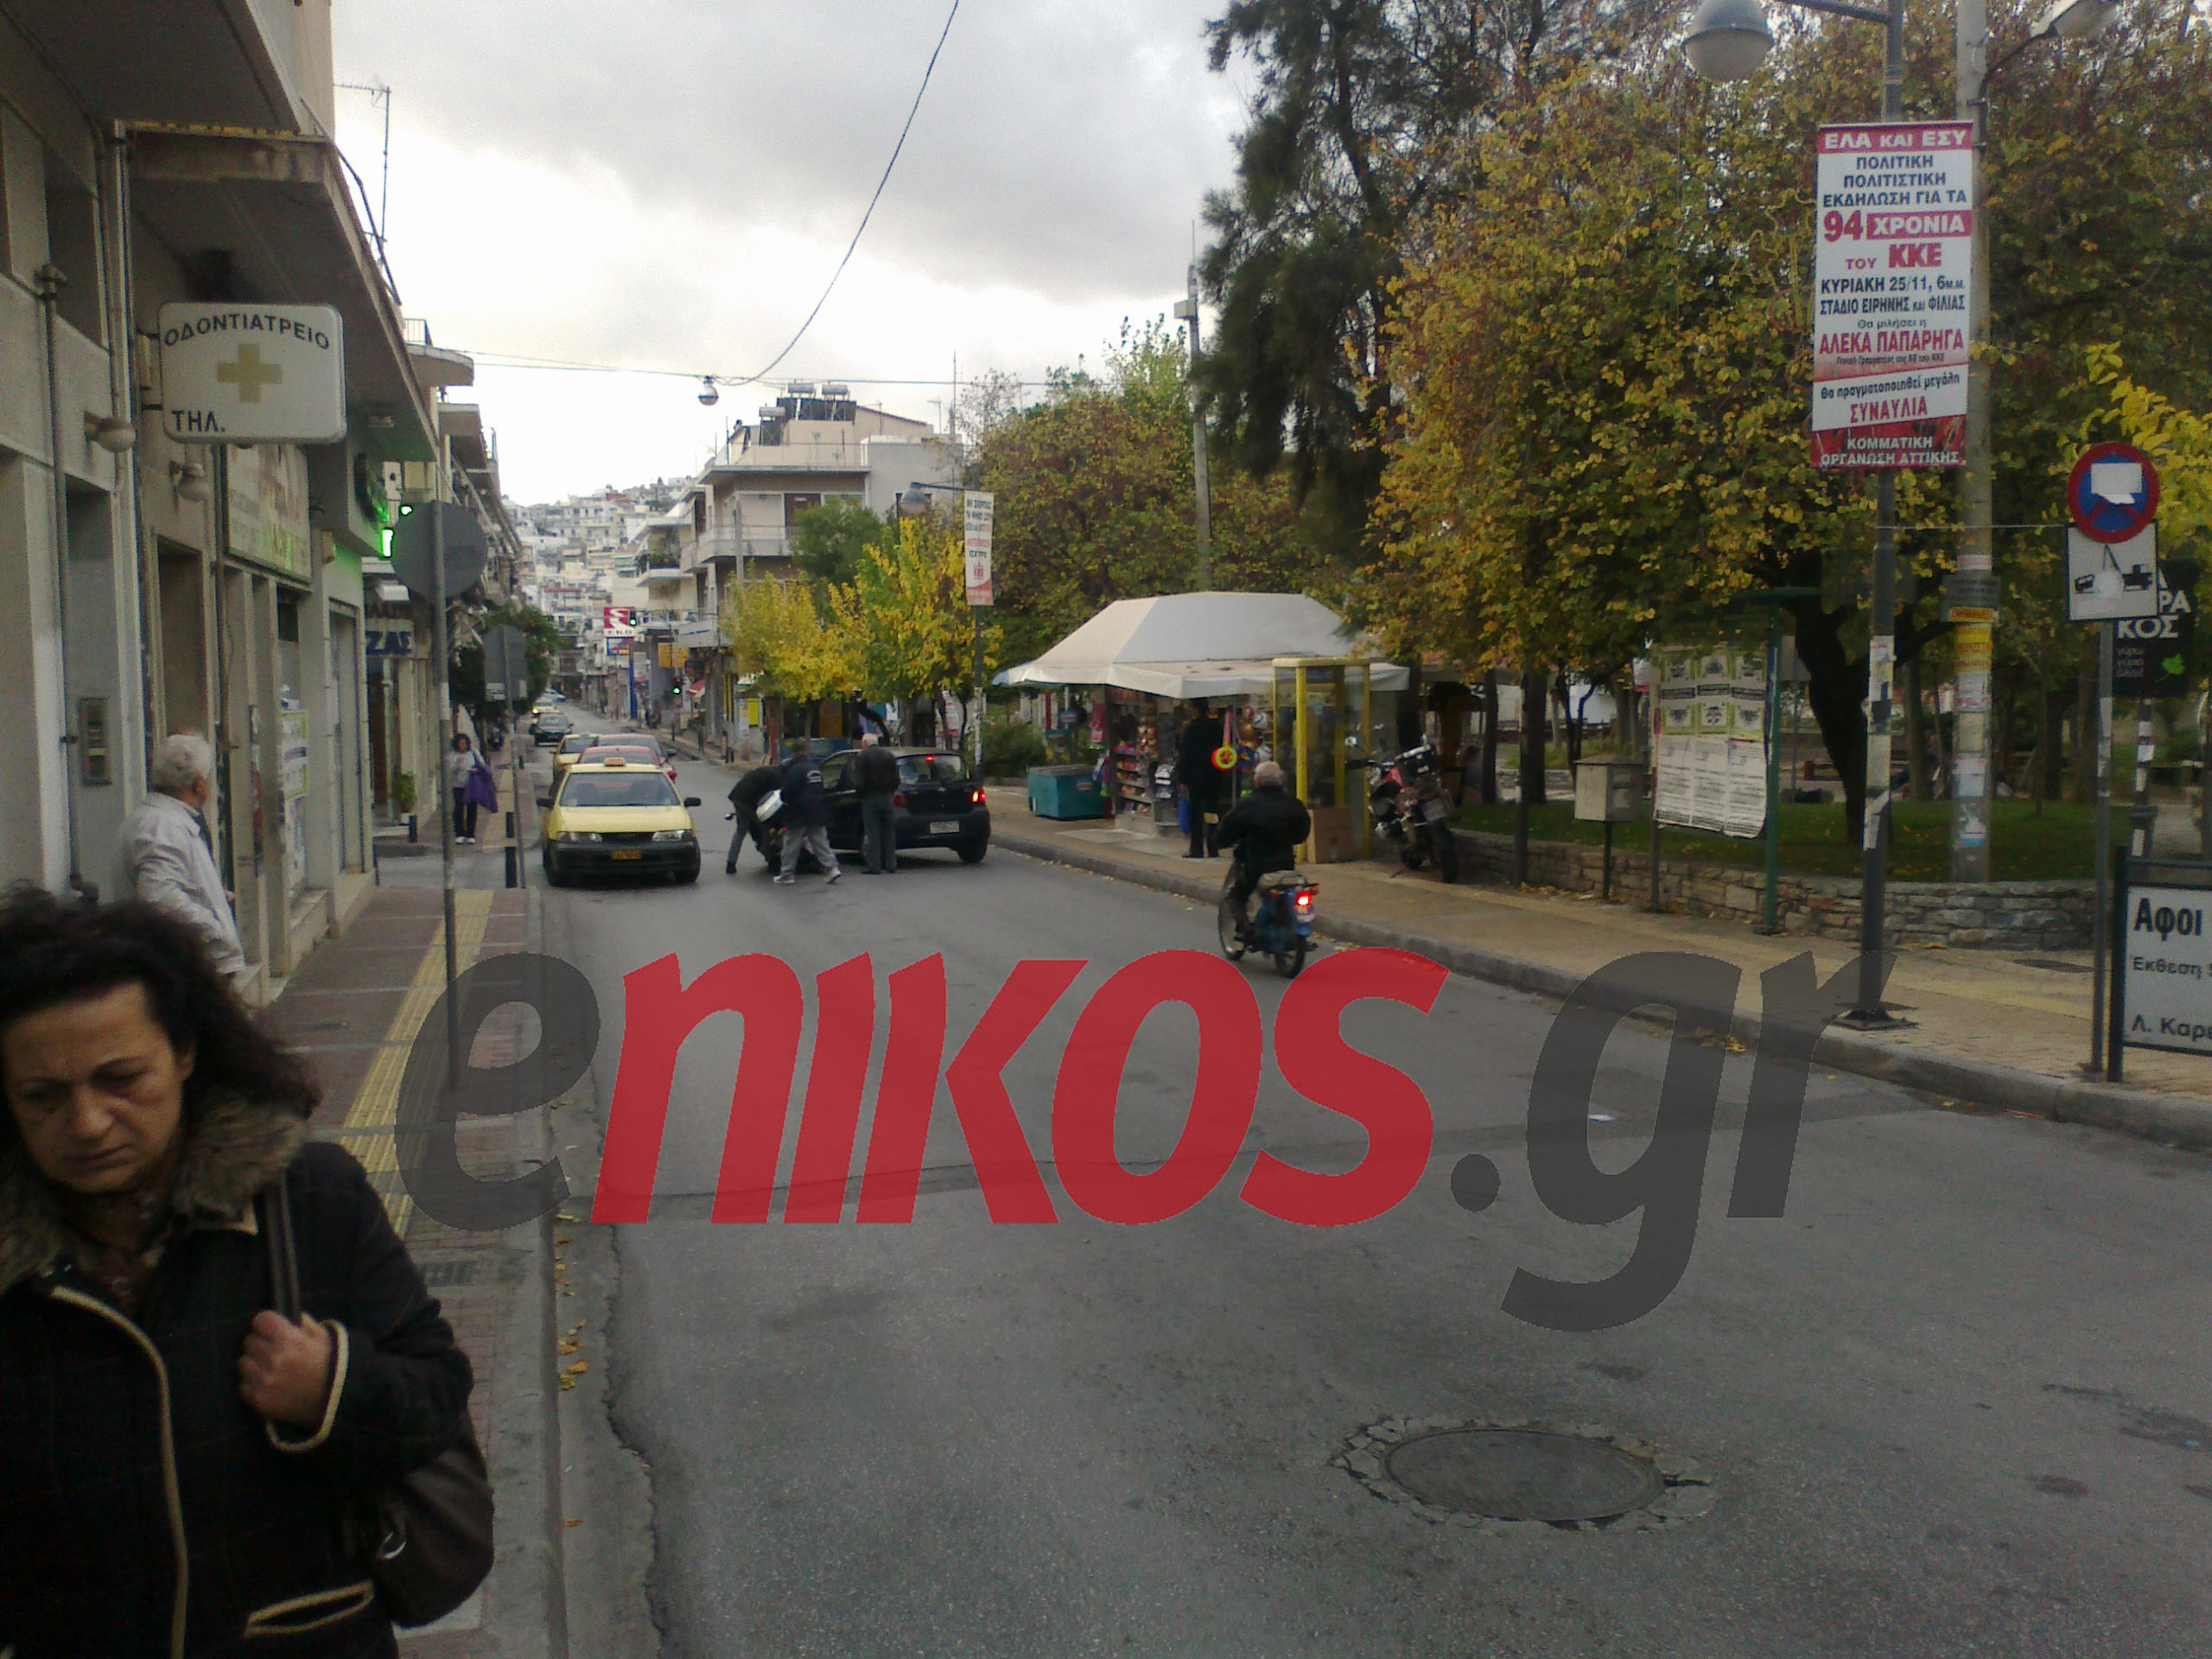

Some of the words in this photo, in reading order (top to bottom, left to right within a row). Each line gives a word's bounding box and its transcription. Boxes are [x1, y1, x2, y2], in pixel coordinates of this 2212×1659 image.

[1824, 132, 1872, 149] ΕΛΑ
[1879, 134, 1913, 148] ΚΑΙ
[1922, 130, 1967, 147] ΕΣΥ
[1856, 155, 1934, 170] ΠΟΛΙΤΙΚΗ
[1843, 172, 1946, 188] ΠΟΛΙΤΙΣΤΙΚΗ
[1823, 191, 1910, 207] ΕΚΔΗΛΩΣΗ
[1916, 190, 1941, 204] ΓΙΑ
[1946, 189, 1967, 203] ΤΑ
[1823, 210, 1864, 243] 94
[1873, 214, 1965, 236] ΧΡΟΝΙΑ
[1845, 257, 1877, 270] ΤΟΥ
[1888, 242, 1942, 269] ΚΚΕ
[1821, 276, 1885, 294] ΚΥΡΙΑΚΗ
[1889, 276, 1933, 293] 25/11,
[1820, 298, 1859, 315] ΣΤΑΔΙΟ
[1862, 296, 1910, 314] ΕΙΡΗΝΗΣ
[1928, 294, 1965, 311] ΦΙΛΙΑΣ
[164, 313, 330, 350] ΟΔΟΝΤΙΑΤΡΕΙΟ
[1858, 319, 1873, 329] Θα
[1877, 317, 1916, 330] μιλήσει
[1819, 332, 1872, 354] ΑΛΕΚΑ
[1877, 328, 1964, 353] ΠΑΠΑΡΗΓΑ
[1837, 374, 1922, 400] πραγματοποιηθεί
[1924, 372, 1960, 391] μεγάλη
[1850, 395, 1929, 423] ΣΥΝΑΥΛΙΑ
[171, 410, 226, 433] ΤΗΛ.
[1847, 435, 1934, 450] ΚΟΜΜΑΤΙΚΗ
[1821, 452, 1896, 466] ΟΡΓΑΝΩΣΗ
[1899, 451, 1959, 465] ΑΤΤΙΚΗΣ
[2117, 614, 2180, 639] ΚΟΣ
